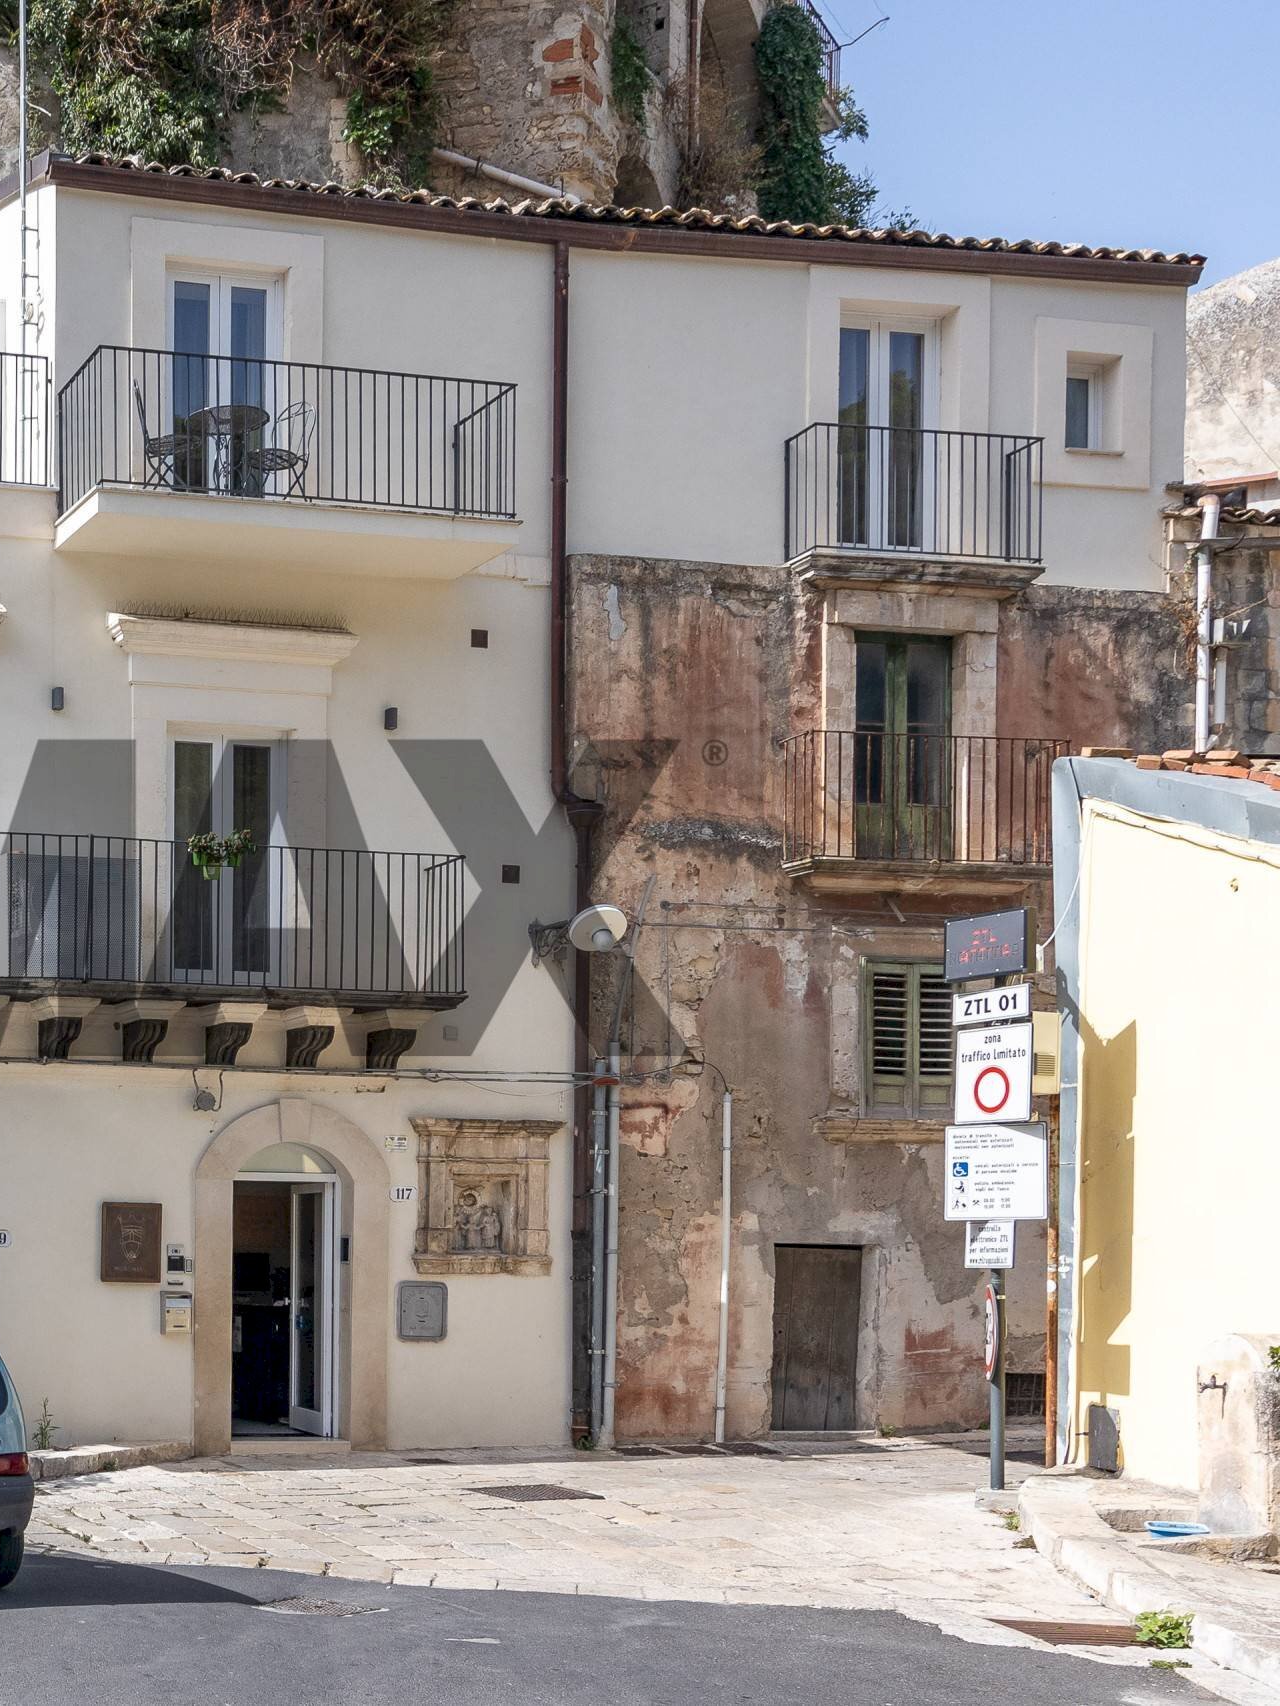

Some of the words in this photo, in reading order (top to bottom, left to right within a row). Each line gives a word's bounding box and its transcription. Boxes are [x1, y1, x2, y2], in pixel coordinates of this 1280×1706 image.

[964, 998, 992, 1016] ZTL
[998, 993, 1018, 1011] 01
[984, 1034, 1002, 1044] zona
[961, 1050, 991, 1063] traffico
[993, 1047, 1026, 1060] limitato
[396, 1187, 413, 1200] 117
